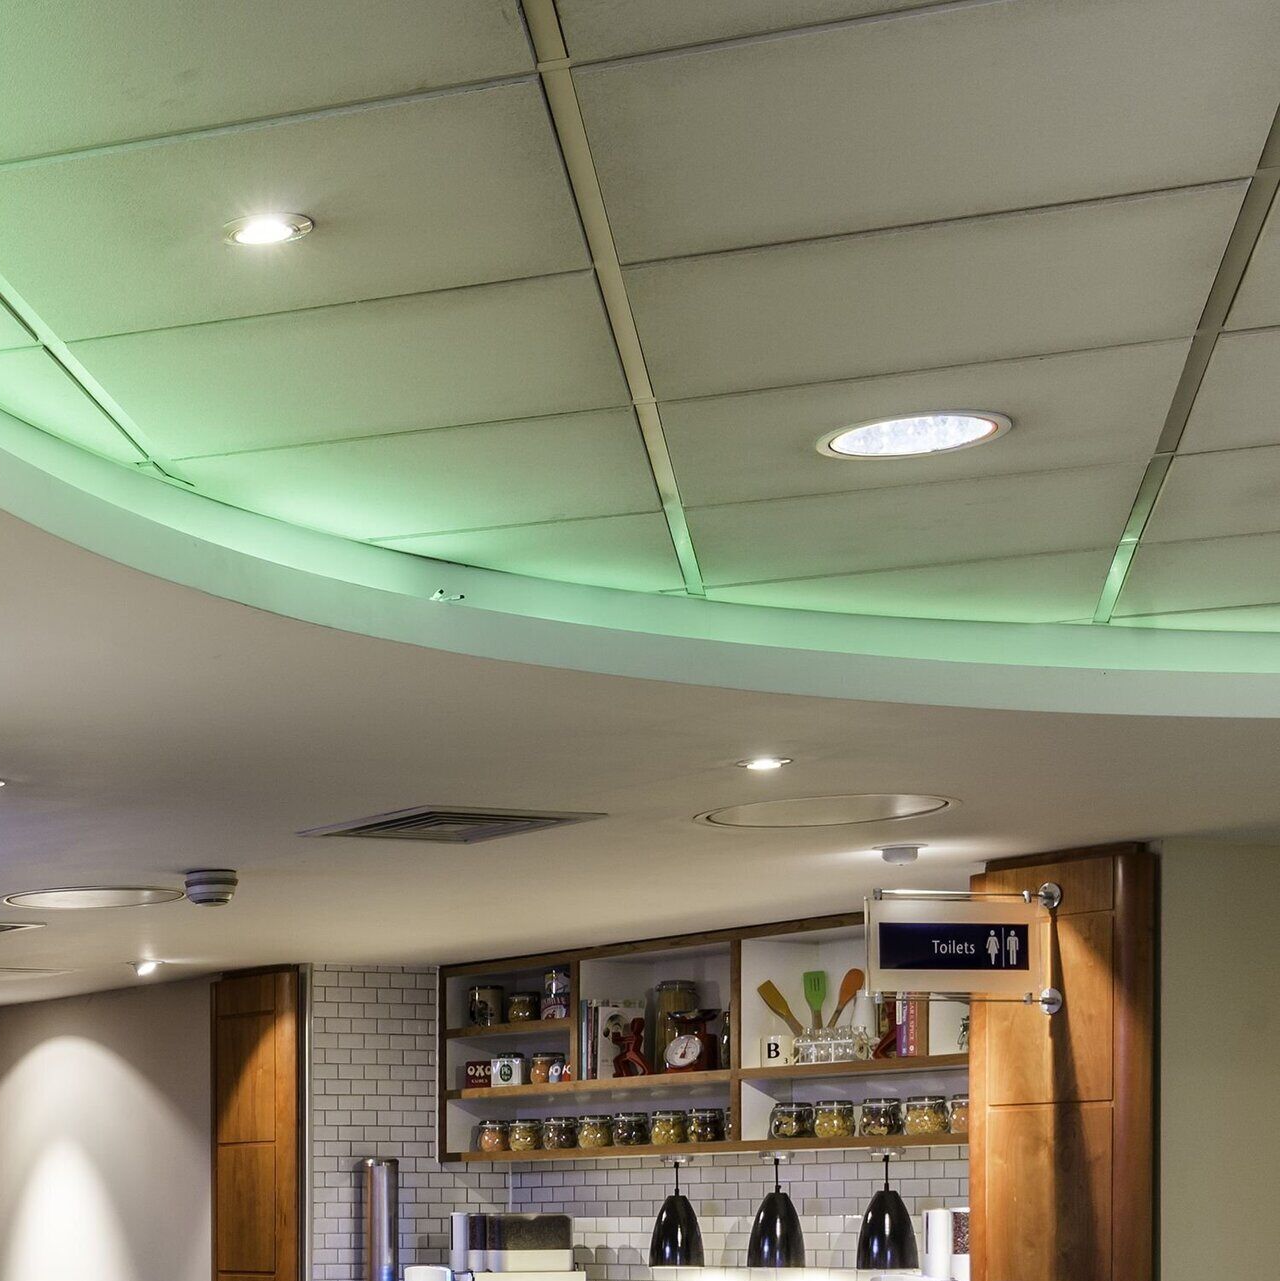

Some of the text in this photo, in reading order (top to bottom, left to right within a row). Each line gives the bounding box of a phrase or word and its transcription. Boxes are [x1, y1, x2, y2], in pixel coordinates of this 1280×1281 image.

[932, 940, 975, 954] Toilets
[767, 1043, 780, 1059] B
[467, 1065, 491, 1077] OXO
